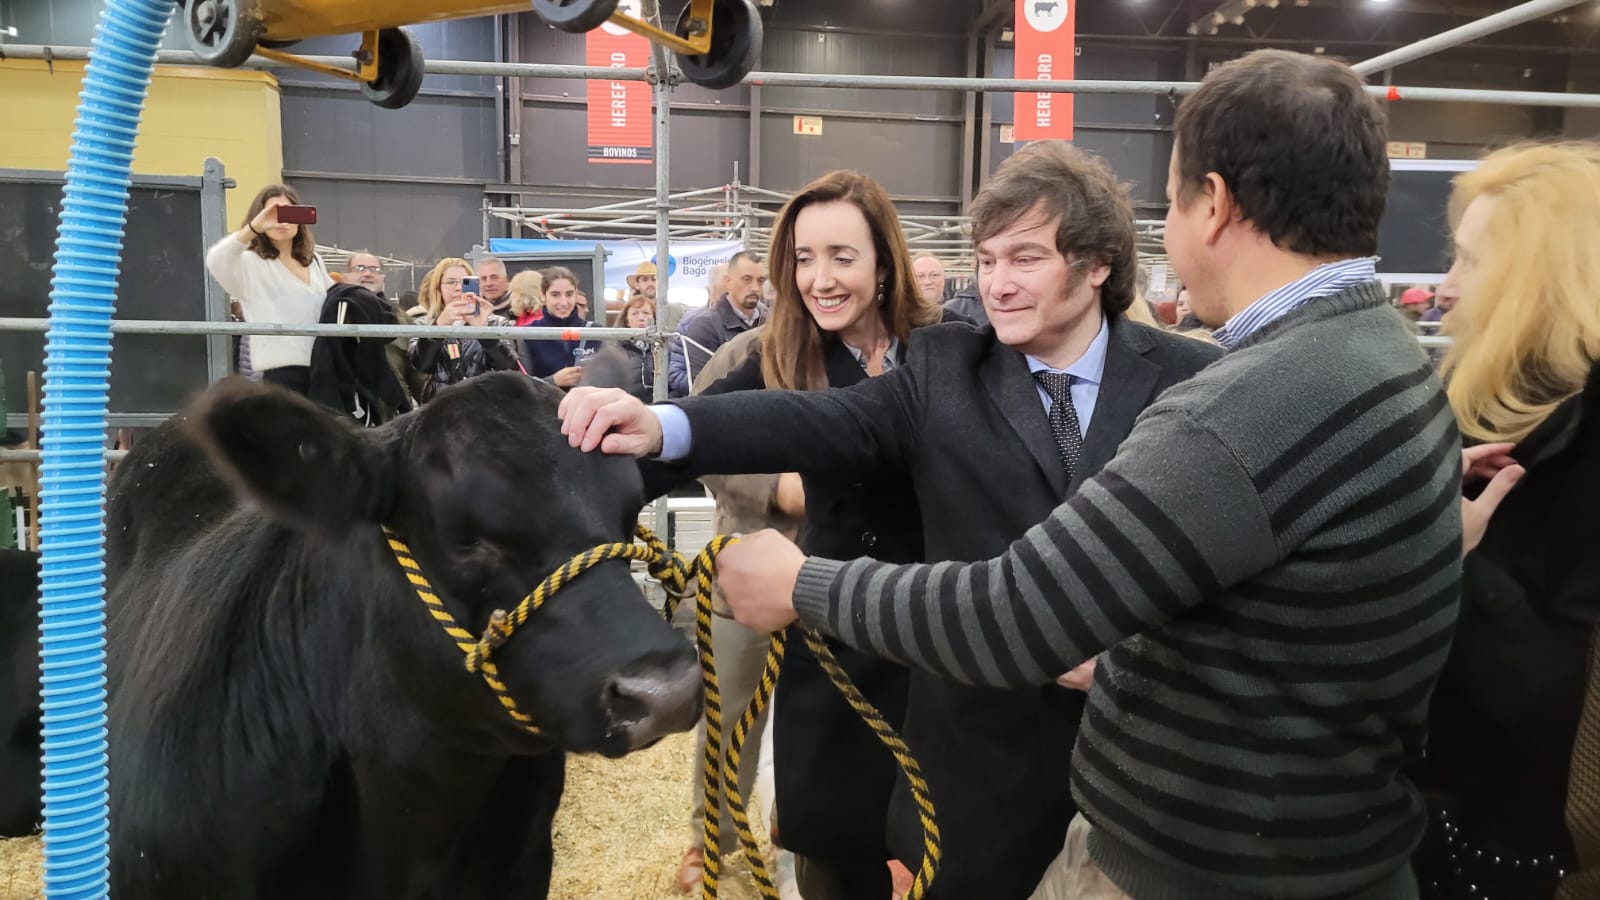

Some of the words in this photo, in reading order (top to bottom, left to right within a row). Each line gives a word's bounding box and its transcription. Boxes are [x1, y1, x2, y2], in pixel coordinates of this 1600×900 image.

[611, 52, 626, 127] HEREFRD
[1036, 53, 1052, 127] HEREORD
[603, 147, 638, 158] BOVINOS
[682, 266, 707, 277] Bagó
